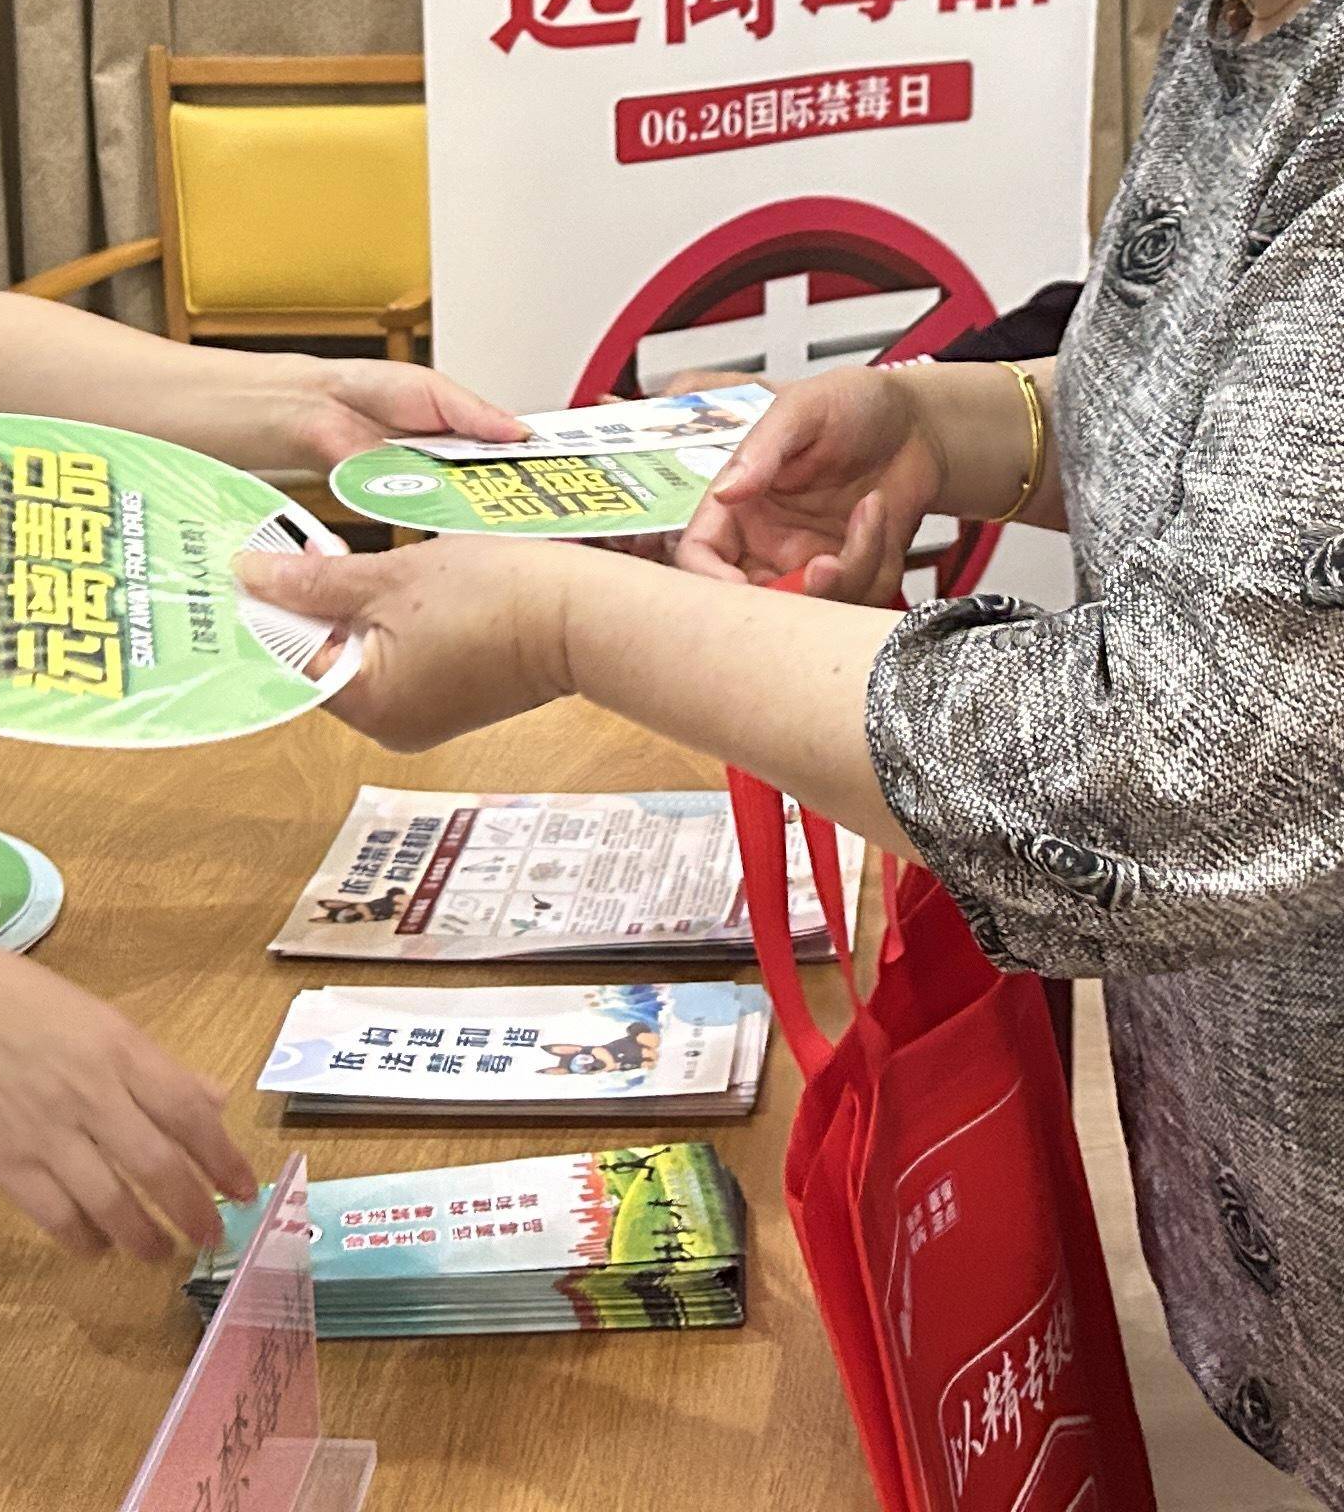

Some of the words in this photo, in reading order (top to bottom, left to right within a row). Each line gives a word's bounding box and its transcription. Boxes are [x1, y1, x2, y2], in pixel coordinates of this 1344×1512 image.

[640, 74, 932, 149] 06.26国际禁毒日
[5, 444, 126, 700] 远离毒品
[358, 1025, 543, 1049] 构建和谐
[329, 1050, 514, 1075] 依法禁毒
